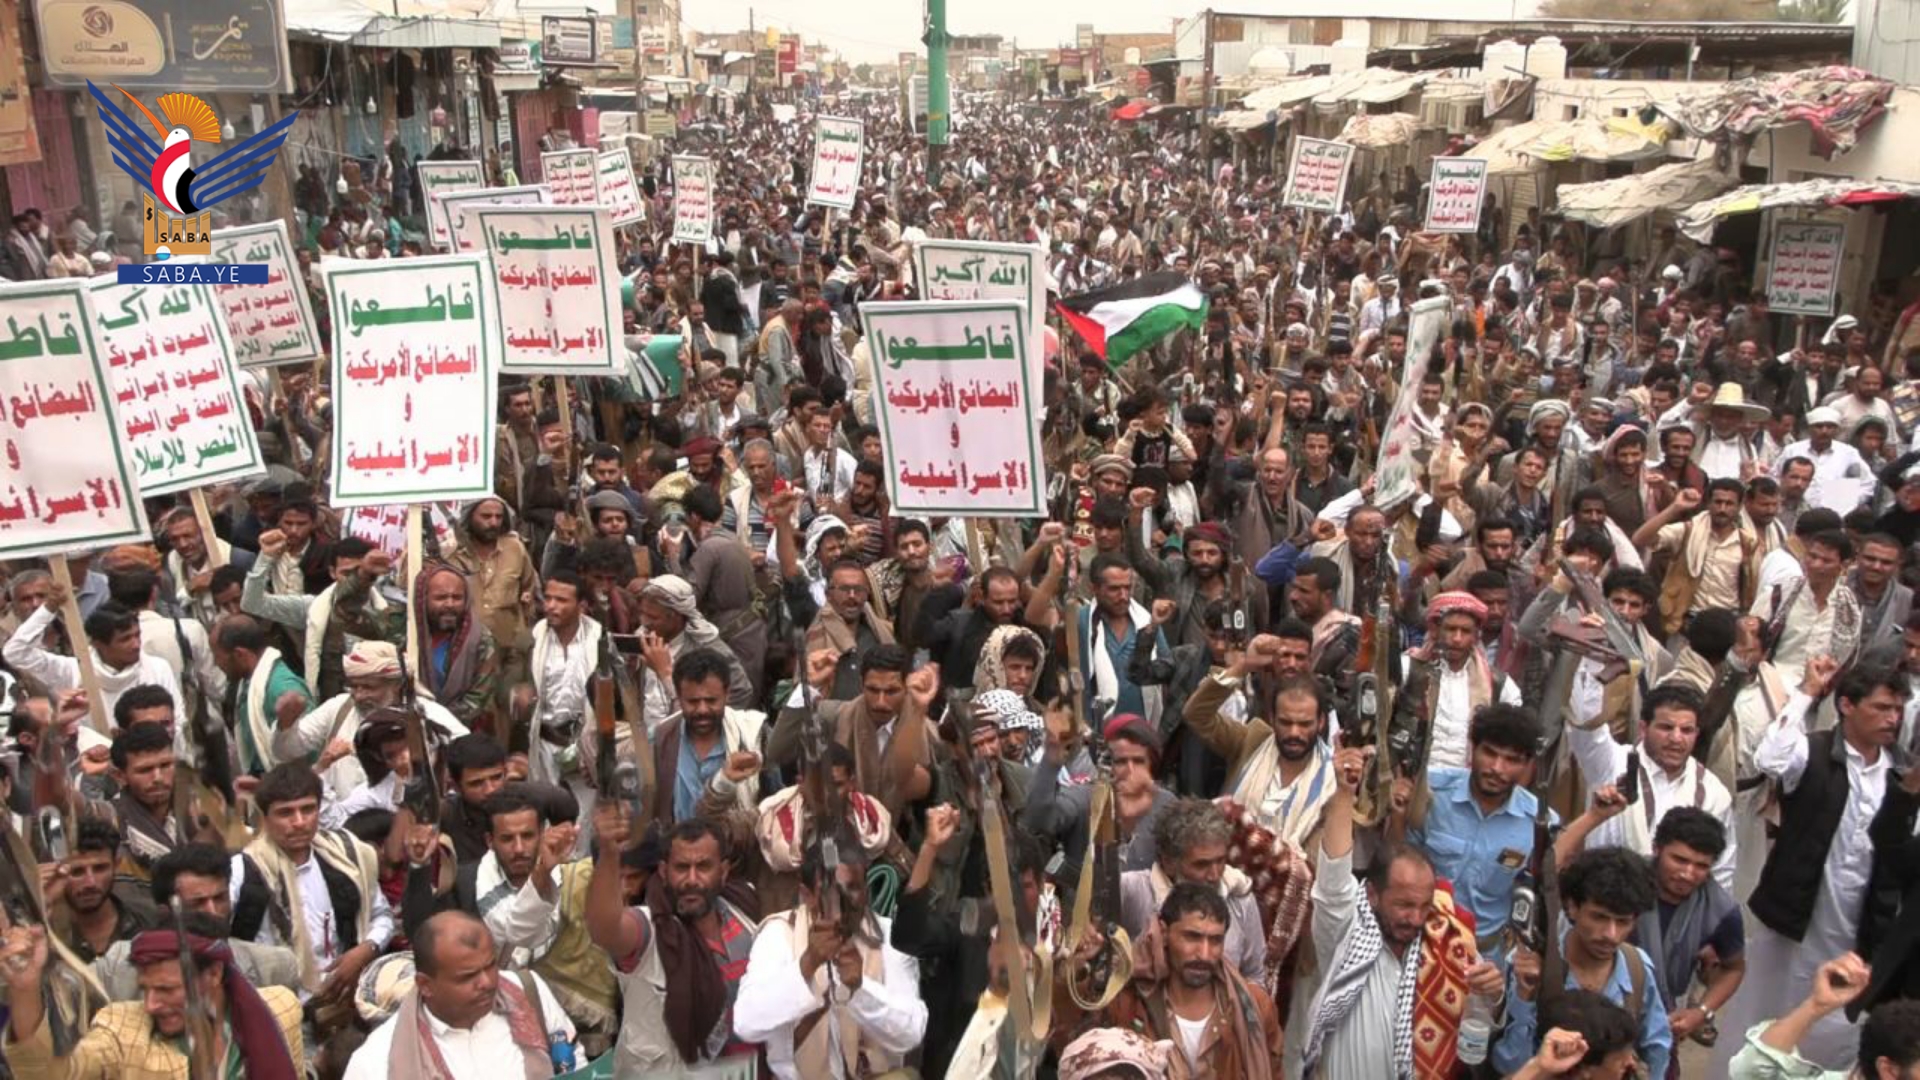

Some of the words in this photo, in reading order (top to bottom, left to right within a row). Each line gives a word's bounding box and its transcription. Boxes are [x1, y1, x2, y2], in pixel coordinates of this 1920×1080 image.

[600, 158, 626, 174] قاط
[207, 240, 239, 265] أك
[245, 240, 283, 262] الله
[489, 224, 593, 256] قاطعوا
[498, 263, 549, 291] الأمريكية
[550, 264, 597, 292] البضائع
[929, 255, 985, 287] أكبر
[988, 259, 1026, 286] الله
[97, 284, 150, 343] أكب
[159, 284, 204, 316] الله
[223, 297, 251, 319] لإسر
[340, 281, 475, 338] قاطعوا
[545, 297, 553, 319] و
[0, 311, 83, 361] قاط
[109, 330, 159, 370] لأمريك
[162, 322, 215, 356] الموت
[236, 337, 262, 360] للإس
[268, 329, 309, 357] النصر
[506, 326, 604, 354] الإسرائيلية
[877, 324, 1016, 370] قاطعوا
[172, 357, 225, 391] الموت
[346, 340, 411, 388] الأمريكية
[414, 343, 478, 384] البضائع
[10, 379, 97, 430] البضائع
[117, 370, 170, 406] لإسرائي
[885, 376, 955, 414] الأمريكية
[958, 379, 1019, 414] البضائع
[165, 403, 191, 433] على
[195, 391, 235, 420] اللعنة
[404, 392, 413, 423] و
[126, 407, 162, 442] اليهو
[949, 421, 960, 449] و
[6, 438, 21, 471] و
[193, 423, 245, 469] النصر
[346, 432, 479, 477] الإسرائيلية
[899, 459, 1030, 496] الإسرائيلية
[0, 476, 121, 529] الإسرائي
